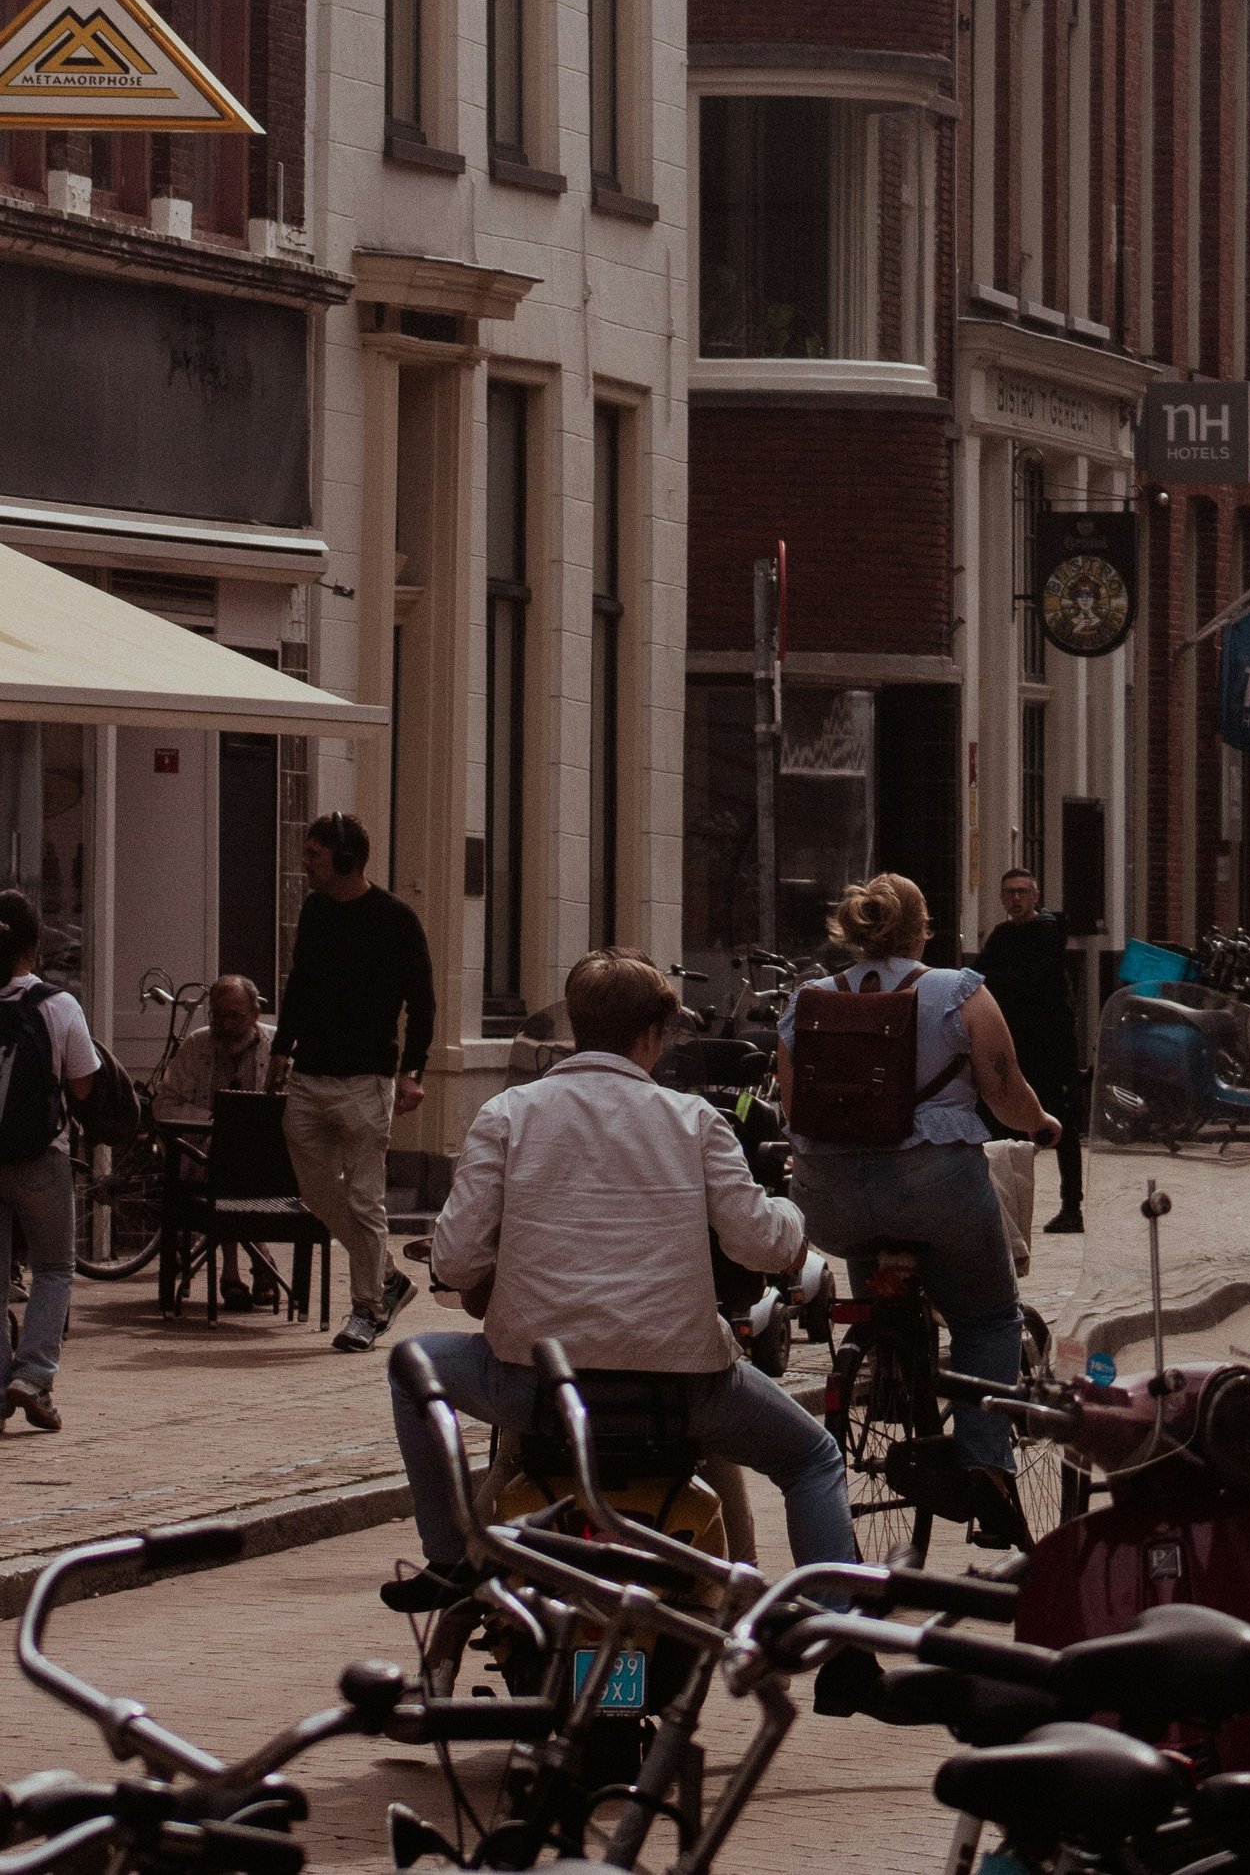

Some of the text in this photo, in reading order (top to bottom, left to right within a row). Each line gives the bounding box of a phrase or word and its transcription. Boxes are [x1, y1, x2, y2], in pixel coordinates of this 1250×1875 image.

[21, 74, 144, 87] METAMORPHOSE
[1166, 446, 1230, 461] HOTELS
[613, 1656, 639, 1677] 99
